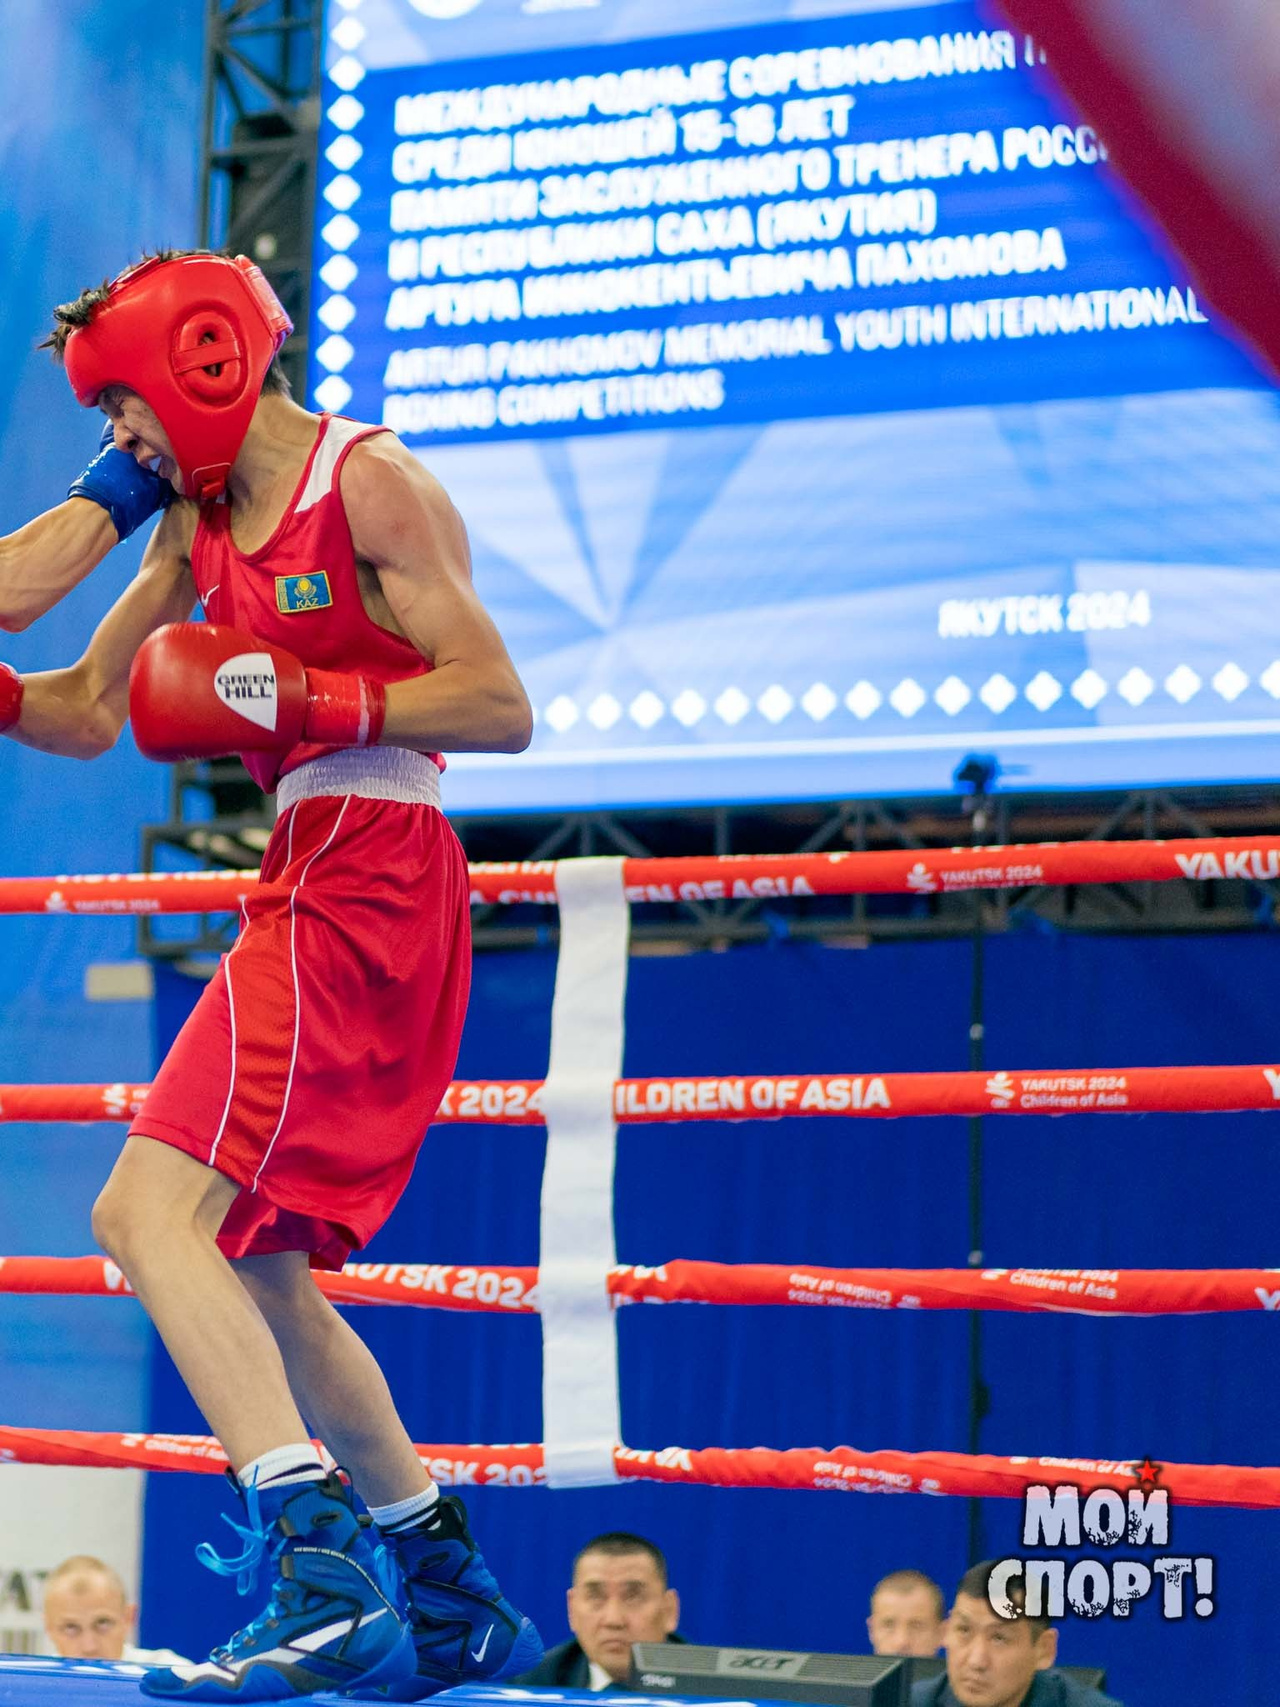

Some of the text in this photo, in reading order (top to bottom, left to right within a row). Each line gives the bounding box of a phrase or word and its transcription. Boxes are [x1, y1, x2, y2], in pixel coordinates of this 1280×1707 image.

[394, 59, 727, 136] МЕЖДУНАРОДНЫЕ
[729, 31, 1015, 98] СОРЕВНОВАНИЯ
[392, 133, 512, 184] СРЕДИ
[777, 94, 856, 142] ЛЕТ
[539, 148, 831, 218] ЗАСЛУЖЕННОГО
[832, 131, 999, 187] ТРЕНЕРА
[1003, 123, 1108, 170] РОСС
[420, 216, 654, 278] РЕСПУБЛИКИ
[655, 206, 755, 255] САХА
[757, 188, 936, 250] (ЯКУТИЯ)
[385, 227, 1067, 330] АРТУРА ИННОКЕНТЬЕВИЧА ПАХОМОВА
[384, 285, 1209, 391] ARTUR PAKHOMOV MEMORIAL YOUTH INTERNATIONAL
[498, 368, 725, 427] COMPETITIONS
[296, 597, 319, 609] KAZ
[938, 589, 1151, 639] ЯКУТСК 2024
[217, 673, 275, 686] GREEN
[224, 686, 273, 699] HILL
[940, 865, 1043, 883] YAKUTSK 2024
[1174, 849, 1280, 880] YAKU
[732, 875, 815, 898] ASIA
[616, 1080, 745, 1114] ILDREN
[750, 1080, 798, 1109] OF
[799, 1077, 891, 1110] ASIA
[1021, 1076, 1127, 1092] YAKUTSK 2024
[1021, 1093, 1128, 1108] Children of Asia
[789, 1273, 819, 1290] Asia
[818, 1279, 835, 1292] of
[835, 1281, 891, 1303] Children
[1010, 1271, 1067, 1291] Children
[1068, 1280, 1085, 1294] of
[1085, 1282, 1118, 1300] Asia
[1038, 1456, 1097, 1472] Children
[1112, 1461, 1138, 1478] As
